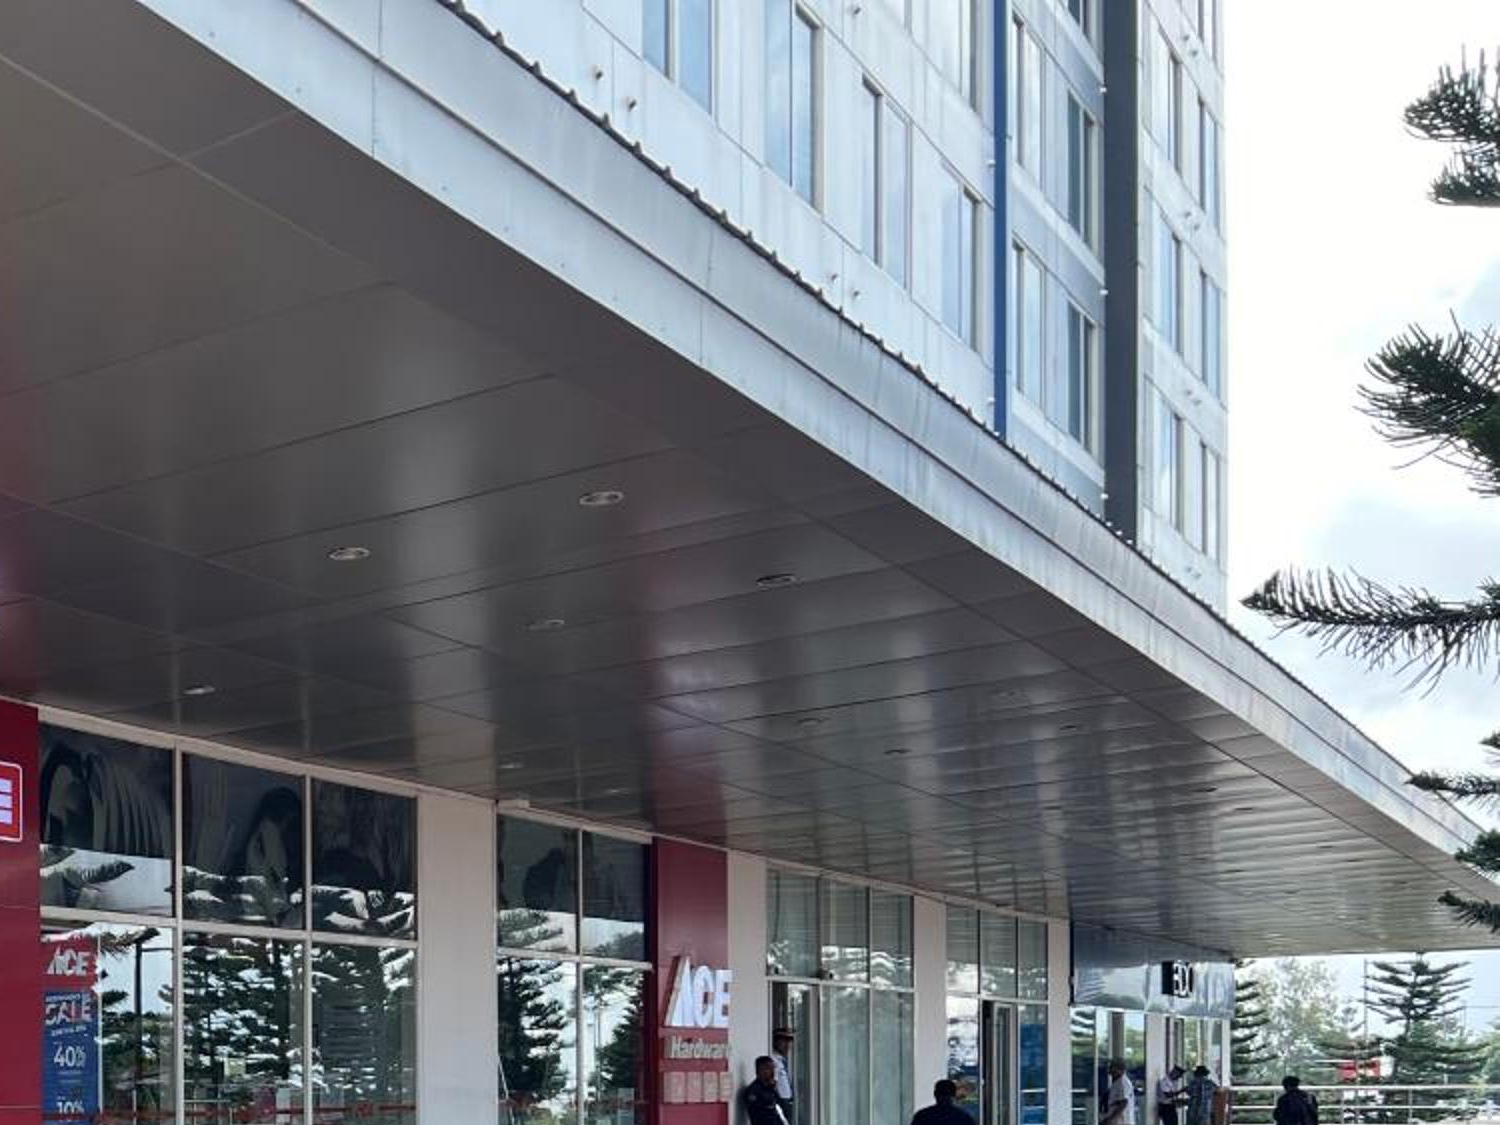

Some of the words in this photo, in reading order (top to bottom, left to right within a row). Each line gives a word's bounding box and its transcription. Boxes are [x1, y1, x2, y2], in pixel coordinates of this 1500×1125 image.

[47, 945, 91, 976] ACE
[665, 956, 733, 1028] ACE
[45, 1001, 93, 1025] SALE
[53, 1045, 86, 1068] 40%
